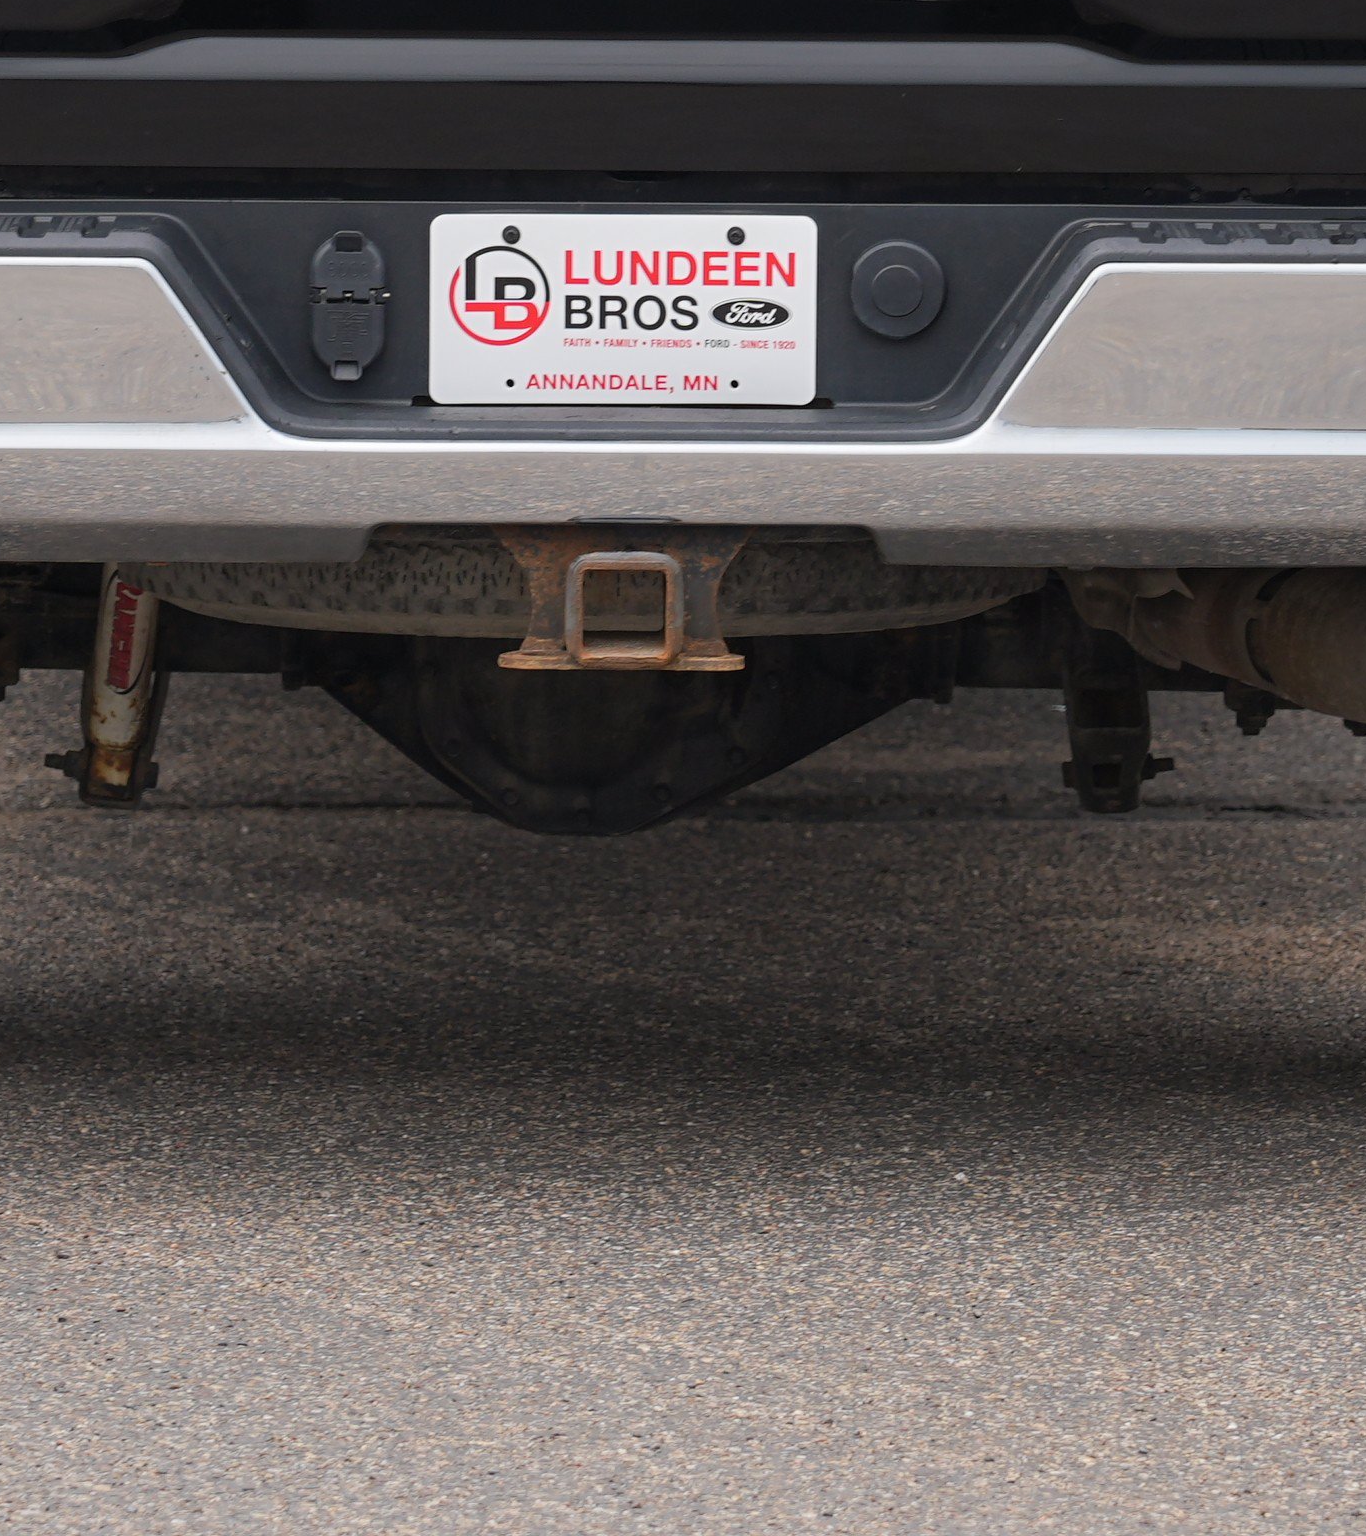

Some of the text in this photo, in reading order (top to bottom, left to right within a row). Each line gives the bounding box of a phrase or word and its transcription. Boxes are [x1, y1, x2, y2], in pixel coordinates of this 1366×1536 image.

[564, 249, 796, 288] LUNDEEN
[564, 294, 777, 331] BROS Ford
[563, 337, 591, 348] FAITH
[603, 338, 639, 349] FAMILY
[650, 339, 692, 349] FRIENDS
[704, 339, 730, 349] FORD
[740, 339, 769, 350] SINCE
[525, 373, 719, 394] ANNANDALE, MN
